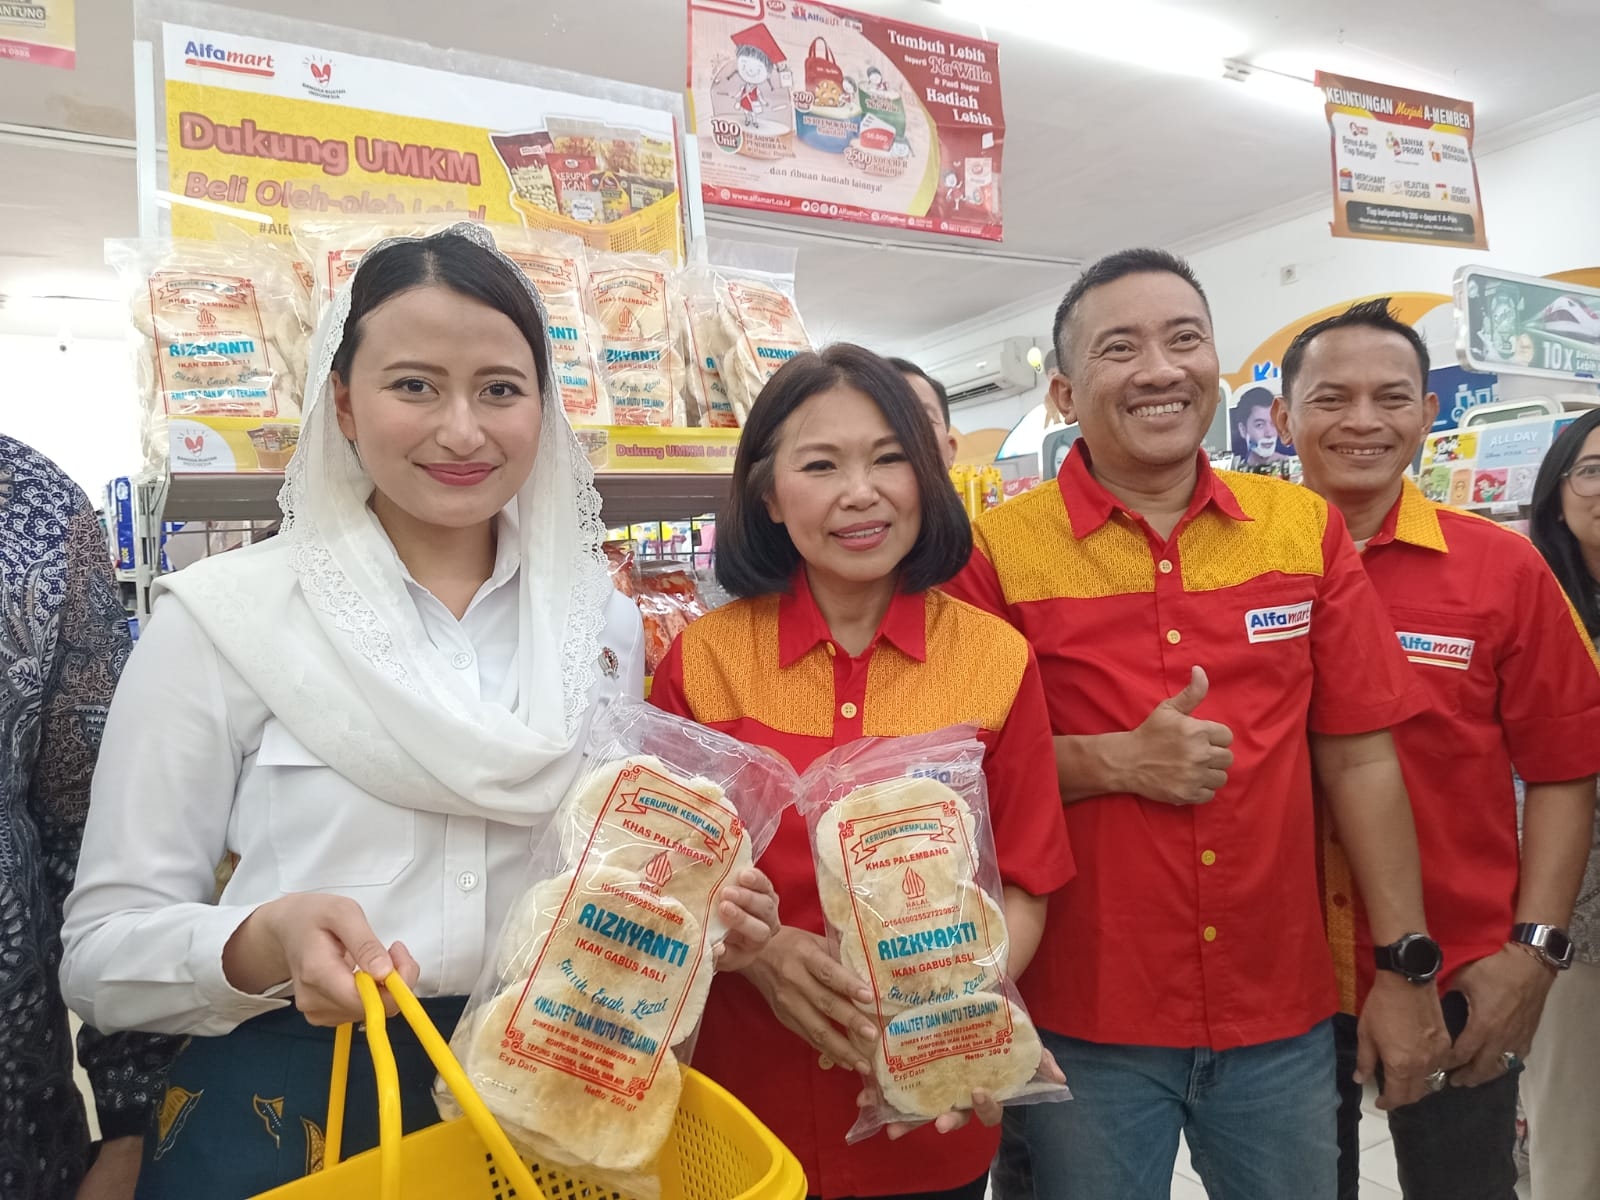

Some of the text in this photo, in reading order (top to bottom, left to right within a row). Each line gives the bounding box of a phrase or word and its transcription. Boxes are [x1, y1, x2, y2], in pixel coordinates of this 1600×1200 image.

[185, 41, 275, 69] Alfamart
[888, 30, 985, 63] Tumbuh Lebih
[793, 91, 813, 104] 200
[927, 88, 979, 110] Hadiah
[1326, 87, 1393, 115] KEUNTUNGAN
[1424, 105, 1471, 129] A-MEMBER
[712, 119, 740, 136] 100
[953, 109, 993, 126] Lebih
[179, 112, 482, 187] Dukung UMKM
[715, 135, 738, 148] Unit
[1402, 146, 1424, 156] PROMO
[845, 148, 872, 165] 2500
[790, 166, 818, 181] ribuan
[821, 172, 850, 186] hadiah
[184, 171, 249, 204] Beli
[255, 180, 405, 216] Oleh-oleh
[606, 348, 661, 363] ZKYANTI
[757, 347, 801, 360] RIZKYA
[1513, 431, 1538, 446] DAY
[616, 443, 664, 460] Dukung
[1250, 609, 1311, 629] Alfamart
[1400, 634, 1472, 658] Alfamart
[639, 795, 721, 840] KERUPUK KEMPLANG
[622, 818, 714, 868] KHAS PALEMBANG
[864, 821, 939, 846] KERUPUK KEMPLANG
[865, 846, 949, 872] KHAS PALEMBANG
[905, 897, 929, 910] HALAL
[577, 902, 690, 968] RIZKYANTI
[877, 921, 978, 961] RIZKYANTI
[575, 936, 667, 988] IKAN GABUS ASLI
[891, 951, 975, 980] IKAN GABUS ASLI
[591, 986, 625, 1014] Enak,
[630, 996, 669, 1020] Lezat
[533, 994, 578, 1024] KWALITET
[576, 1011, 593, 1032] DAN
[593, 1016, 620, 1042] MUTU
[619, 1025, 660, 1058] TERJAMIN
[887, 1016, 925, 1038] KWALITET
[925, 1013, 941, 1029] DAN
[941, 1008, 962, 1026] MUTU
[962, 999, 999, 1020] TERJAMIN
[498, 1051, 539, 1074] Exp Date
